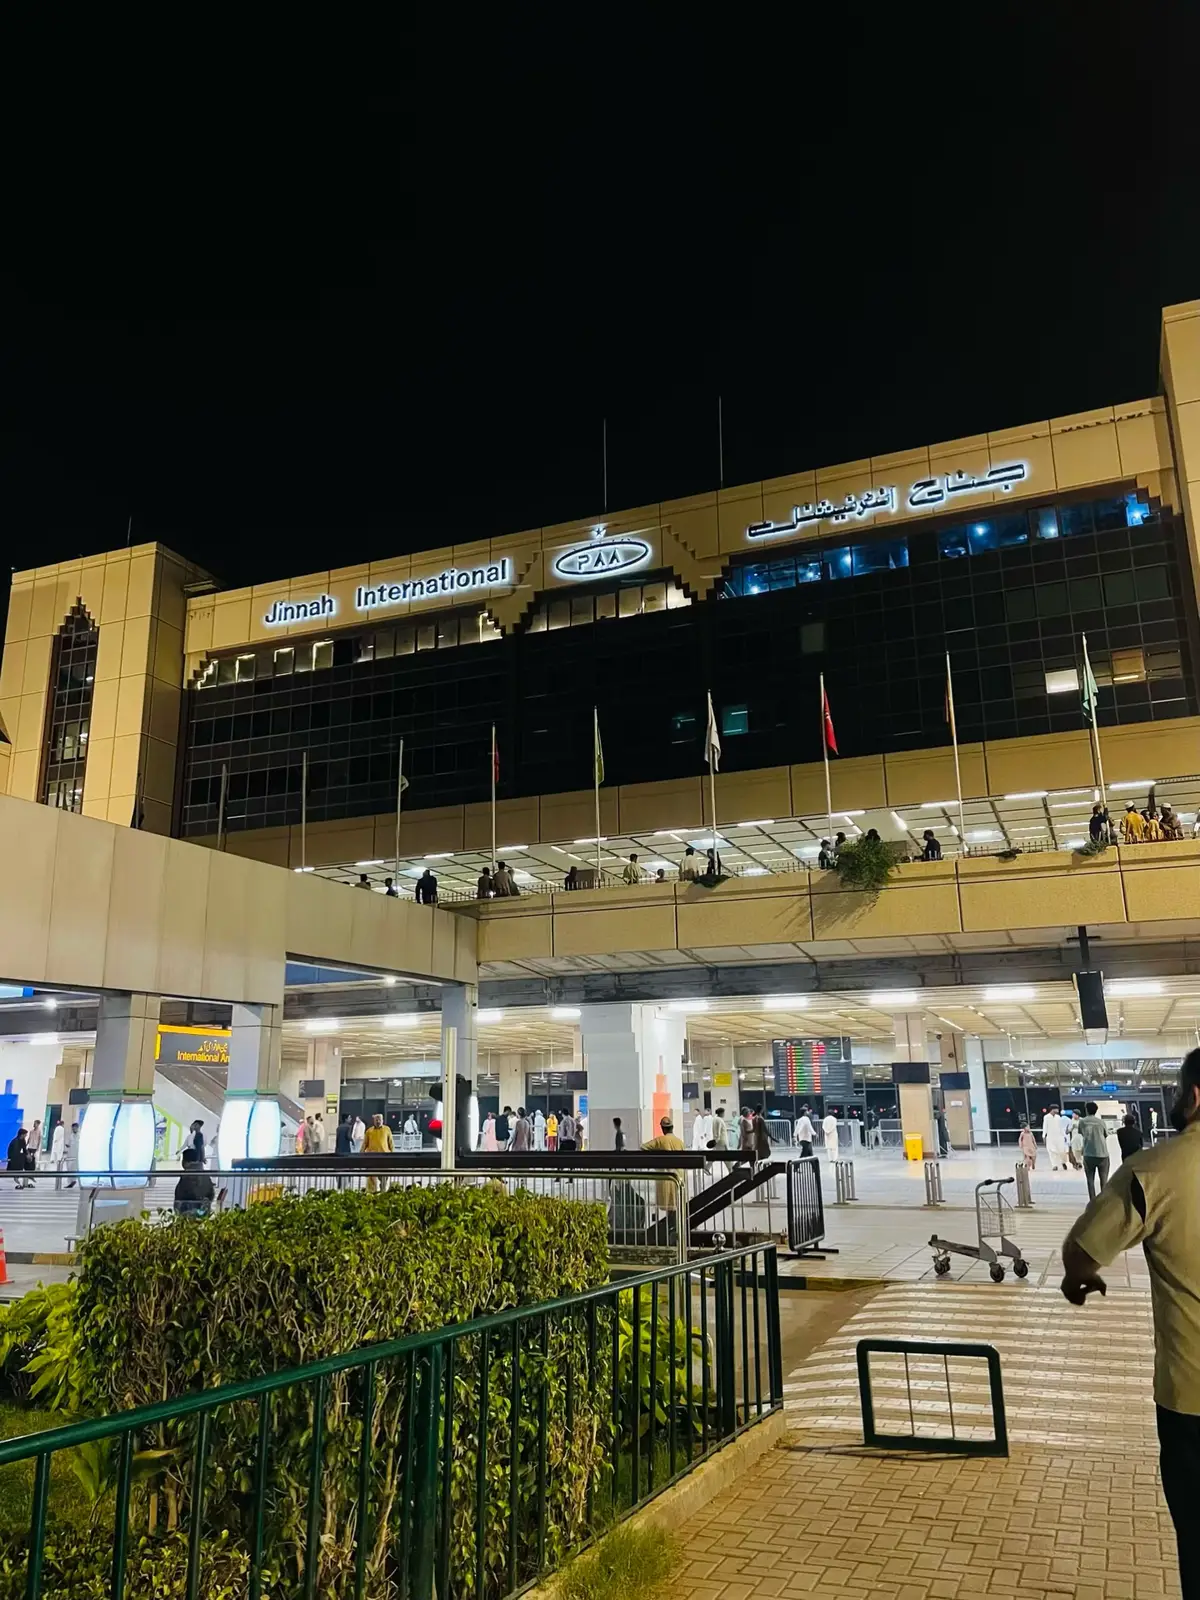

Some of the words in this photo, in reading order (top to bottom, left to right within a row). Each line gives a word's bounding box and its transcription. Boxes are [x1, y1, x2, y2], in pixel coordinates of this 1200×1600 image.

[909, 463, 1025, 506] جناح
[578, 547, 620, 571] PAA
[265, 595, 334, 623] Jinnah
[357, 558, 508, 606] International
[177, 1050, 219, 1062] International
